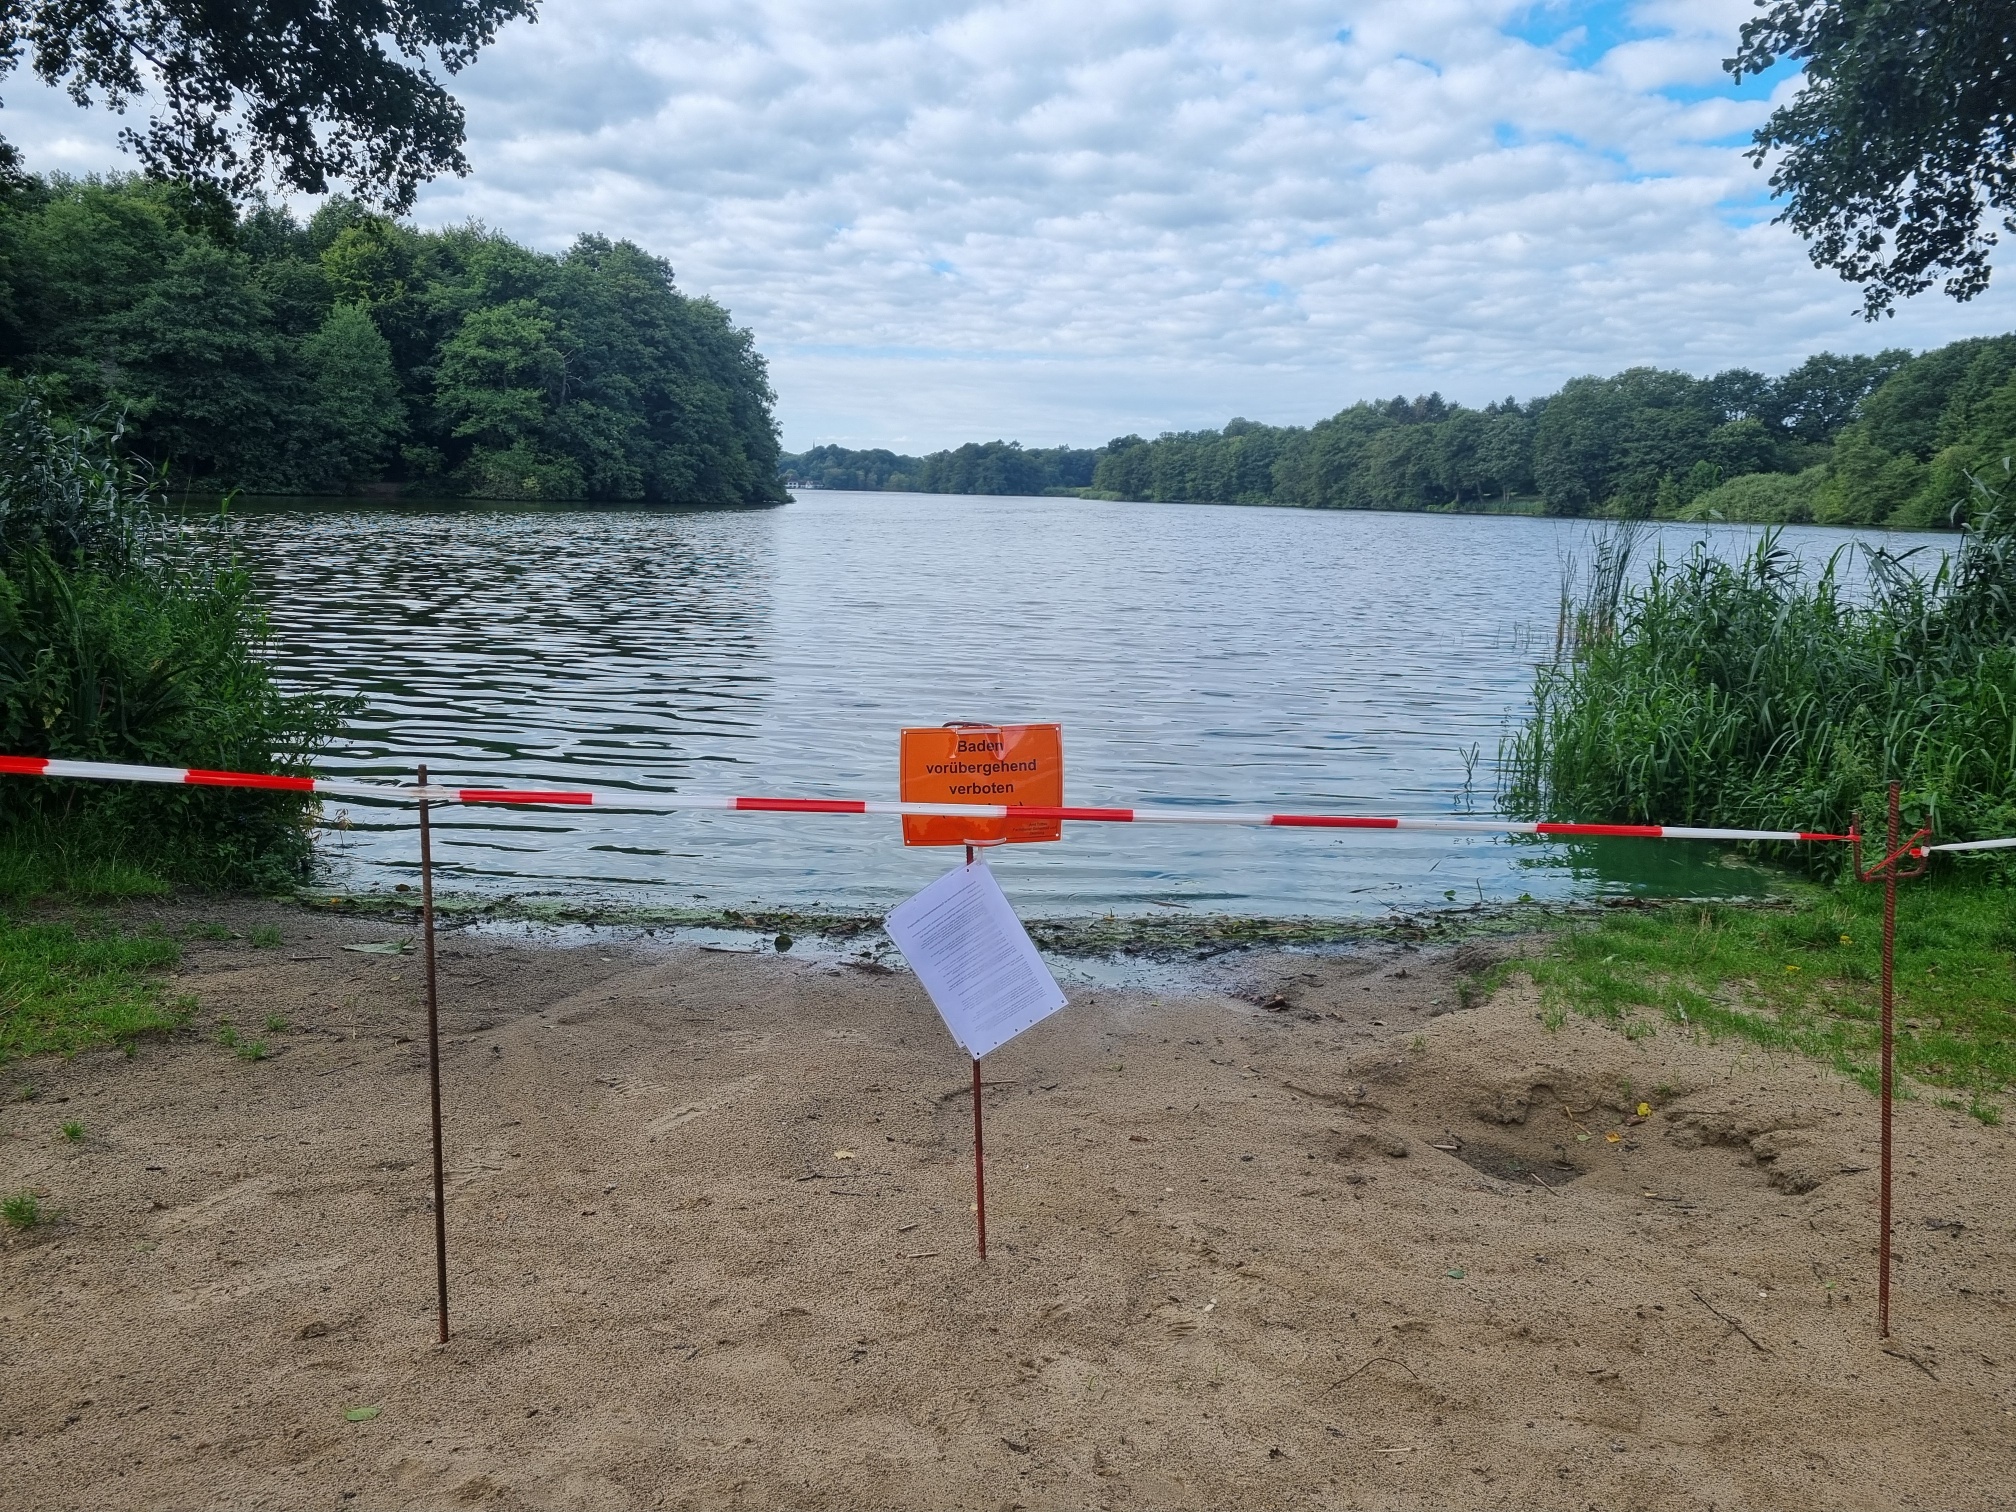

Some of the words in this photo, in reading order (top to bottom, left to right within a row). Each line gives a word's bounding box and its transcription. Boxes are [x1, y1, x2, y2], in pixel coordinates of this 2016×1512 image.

[958, 740, 1004, 752] Baden
[926, 759, 1037, 776] vorübergehend
[949, 782, 1014, 795] verboten
